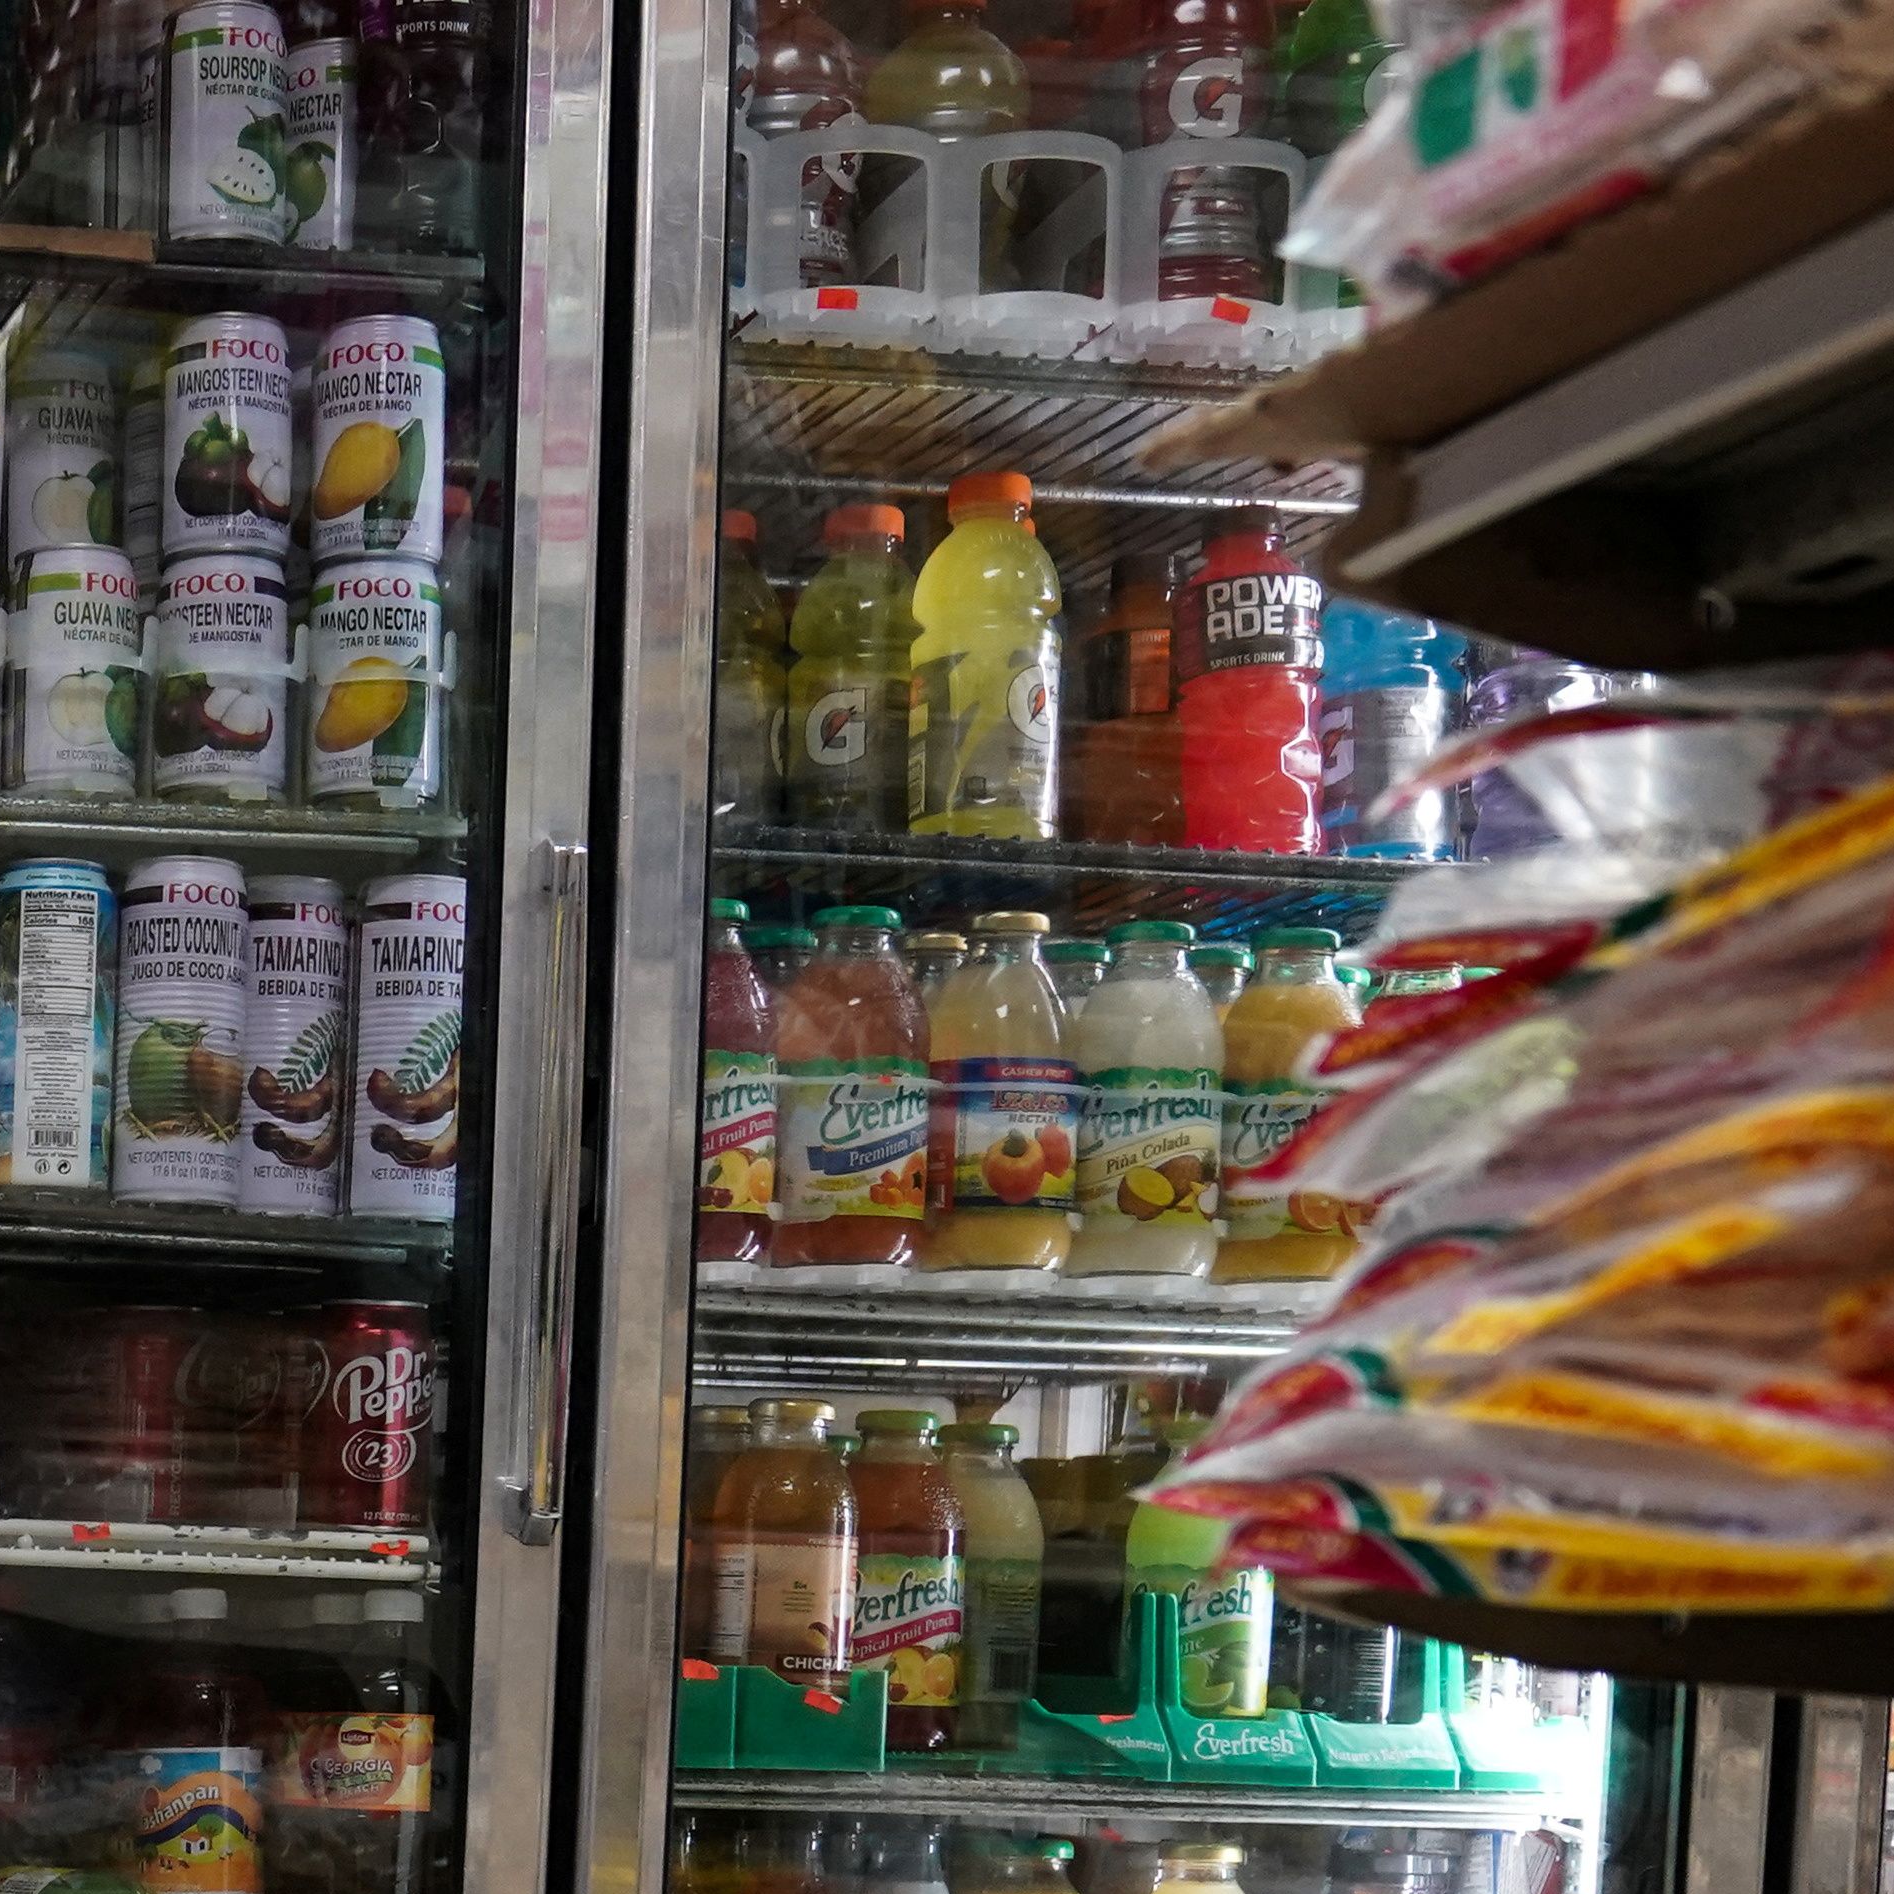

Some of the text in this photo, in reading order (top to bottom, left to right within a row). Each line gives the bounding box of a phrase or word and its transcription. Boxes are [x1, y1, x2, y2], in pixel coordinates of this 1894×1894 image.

[439, 21, 470, 33] DRINK
[199, 56, 267, 80] SOURSOP
[289, 94, 342, 121] NECTAR
[1167, 57, 1244, 138] G
[213, 339, 280, 364] FOCO
[333, 342, 405, 368] FOCO
[177, 368, 263, 399] MANGOSTEEN
[365, 372, 422, 397] NECTAR
[37, 407, 94, 433] GUAVA
[174, 573, 246, 597] FOCO
[338, 577, 412, 600] FOCO
[1206, 575, 1322, 612] POWER
[54, 601, 113, 627] GUAVA
[226, 603, 273, 632] NECTAR
[372, 607, 427, 633] NECTAR
[1207, 605, 1285, 643] ADE
[384, 634, 419, 648] MANGO
[1254, 652, 1285, 663] DRINK
[805, 687, 867, 767] G
[25, 890, 96, 901] Nutrition Facts
[168, 883, 236, 907] FOCO
[127, 918, 181, 958] ROASTED
[131, 962, 224, 981] JUGO DE COCO
[258, 980, 325, 998] BEBIDA DE
[375, 980, 445, 998] BEBIDA DE
[717, 1127, 747, 1148] Fruit
[848, 1140, 909, 1167] Premium
[1106, 1133, 1191, 1174] Piña Colada
[385, 1347, 427, 1388] Dr
[364, 1441, 393, 1468] 23
[893, 1625, 922, 1646] Fruit
[342, 1733, 369, 1742] Lipton
[1194, 1723, 1294, 1761] Everfresh
[325, 1758, 393, 1774] GEORGIA
